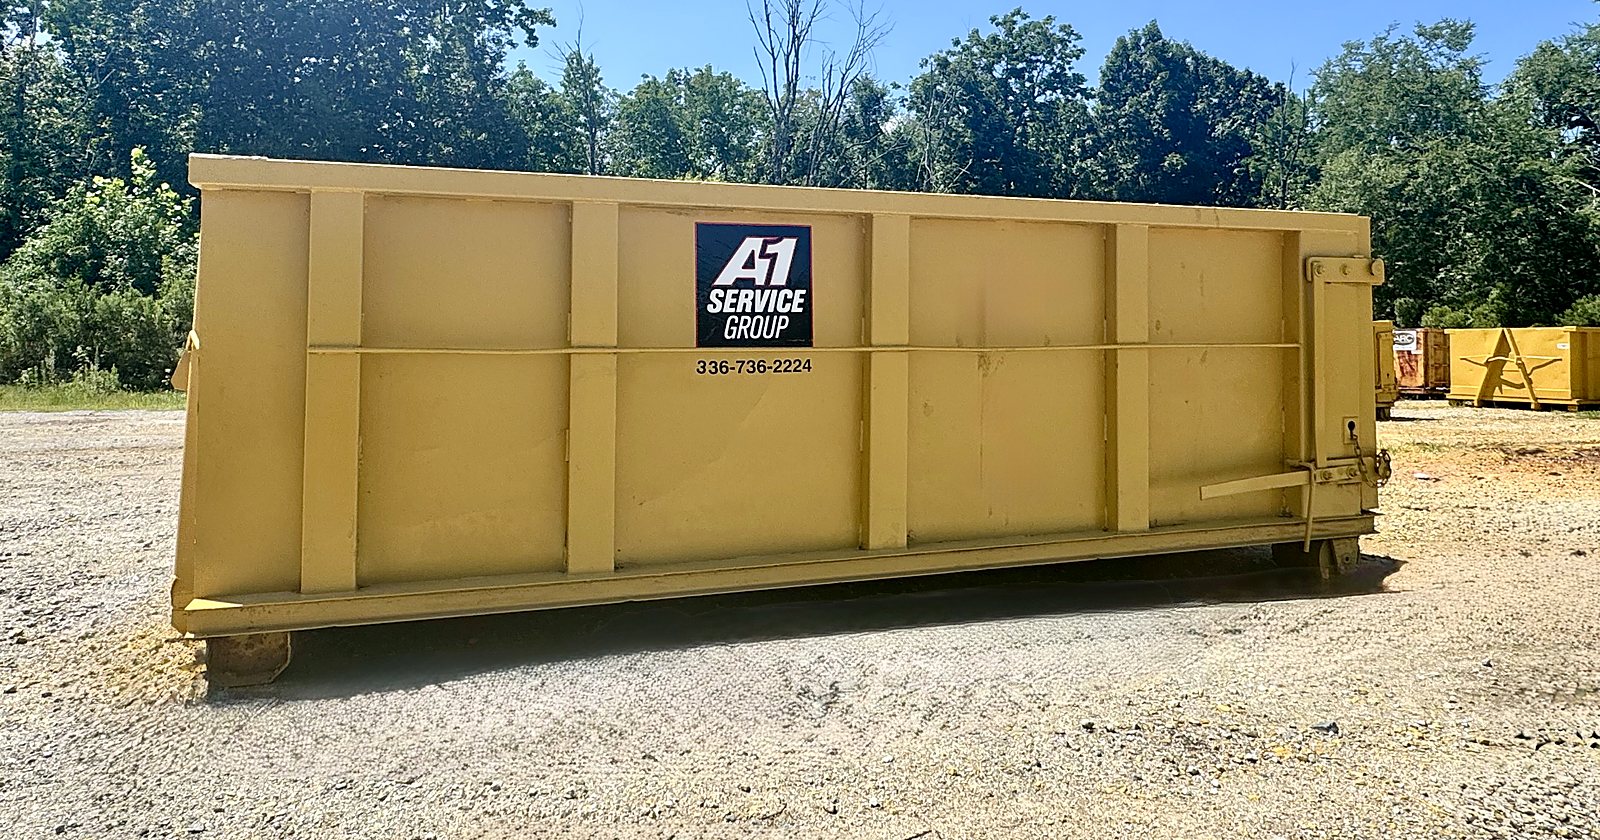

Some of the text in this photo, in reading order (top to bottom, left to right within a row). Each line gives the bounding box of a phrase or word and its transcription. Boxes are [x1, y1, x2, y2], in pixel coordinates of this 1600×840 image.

[713, 237, 798, 285] A1
[706, 288, 806, 313] SERVICE
[724, 315, 789, 339] GROUP
[696, 359, 812, 374] 336-736-2224
